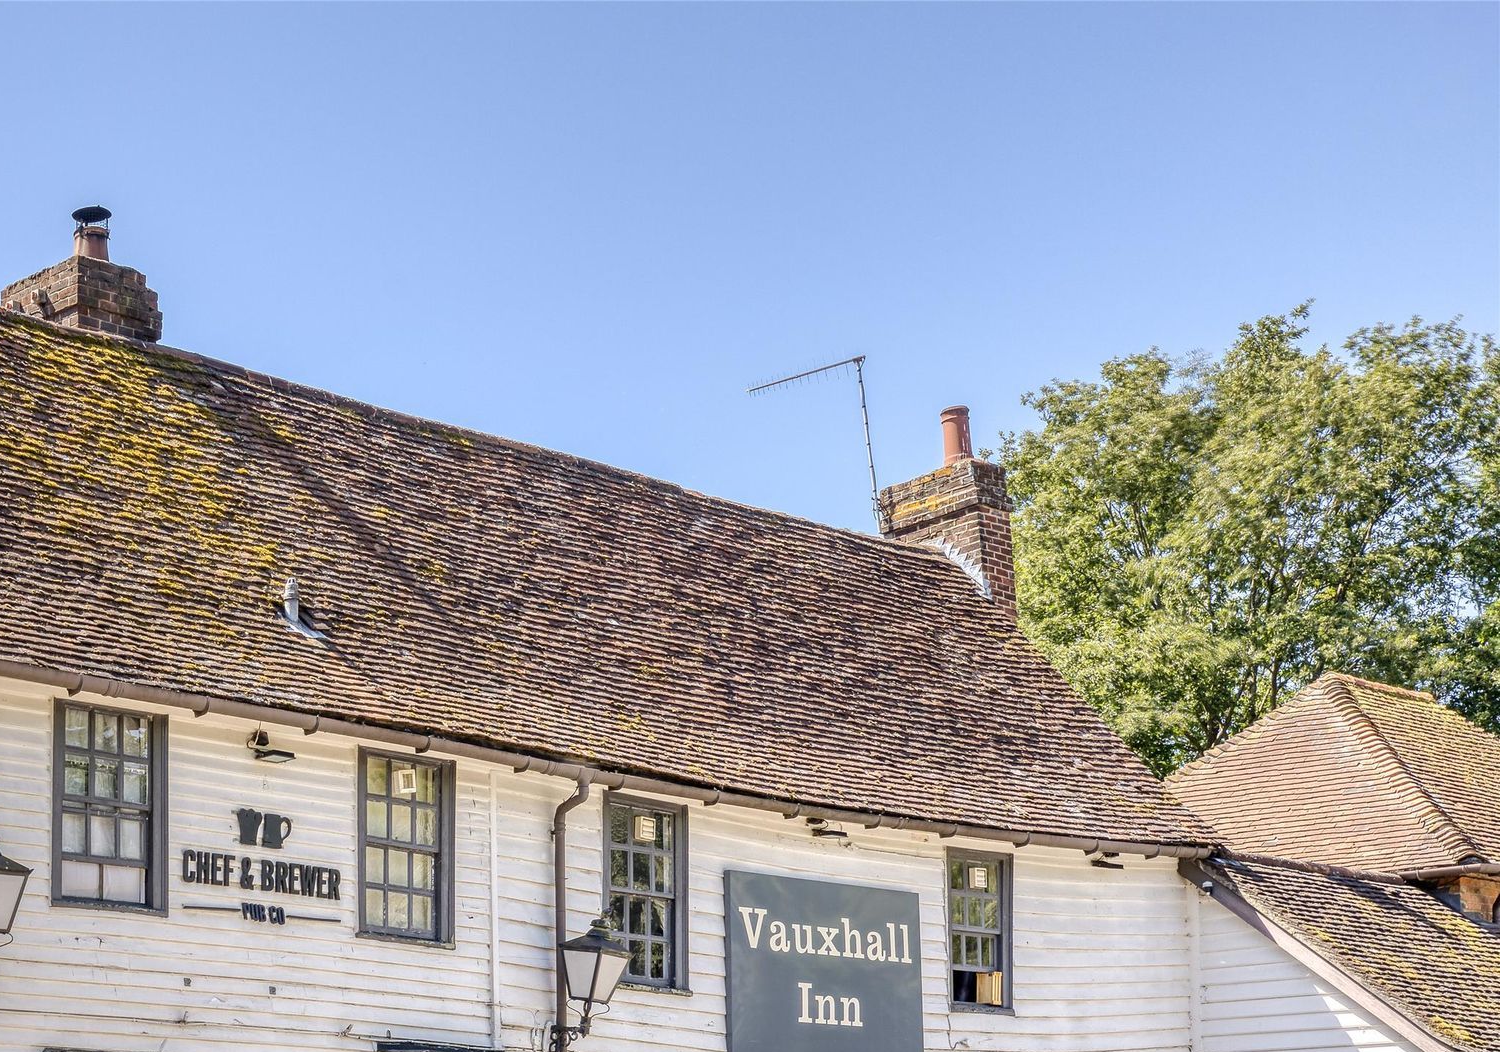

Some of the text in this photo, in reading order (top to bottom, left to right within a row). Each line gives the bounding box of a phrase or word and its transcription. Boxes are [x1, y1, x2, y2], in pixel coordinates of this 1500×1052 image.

[182, 850, 341, 900] CHEF & BREWER
[241, 902, 286, 926] PUB CO
[738, 906, 912, 964] Vauxhall
[797, 982, 863, 1027] Inn
